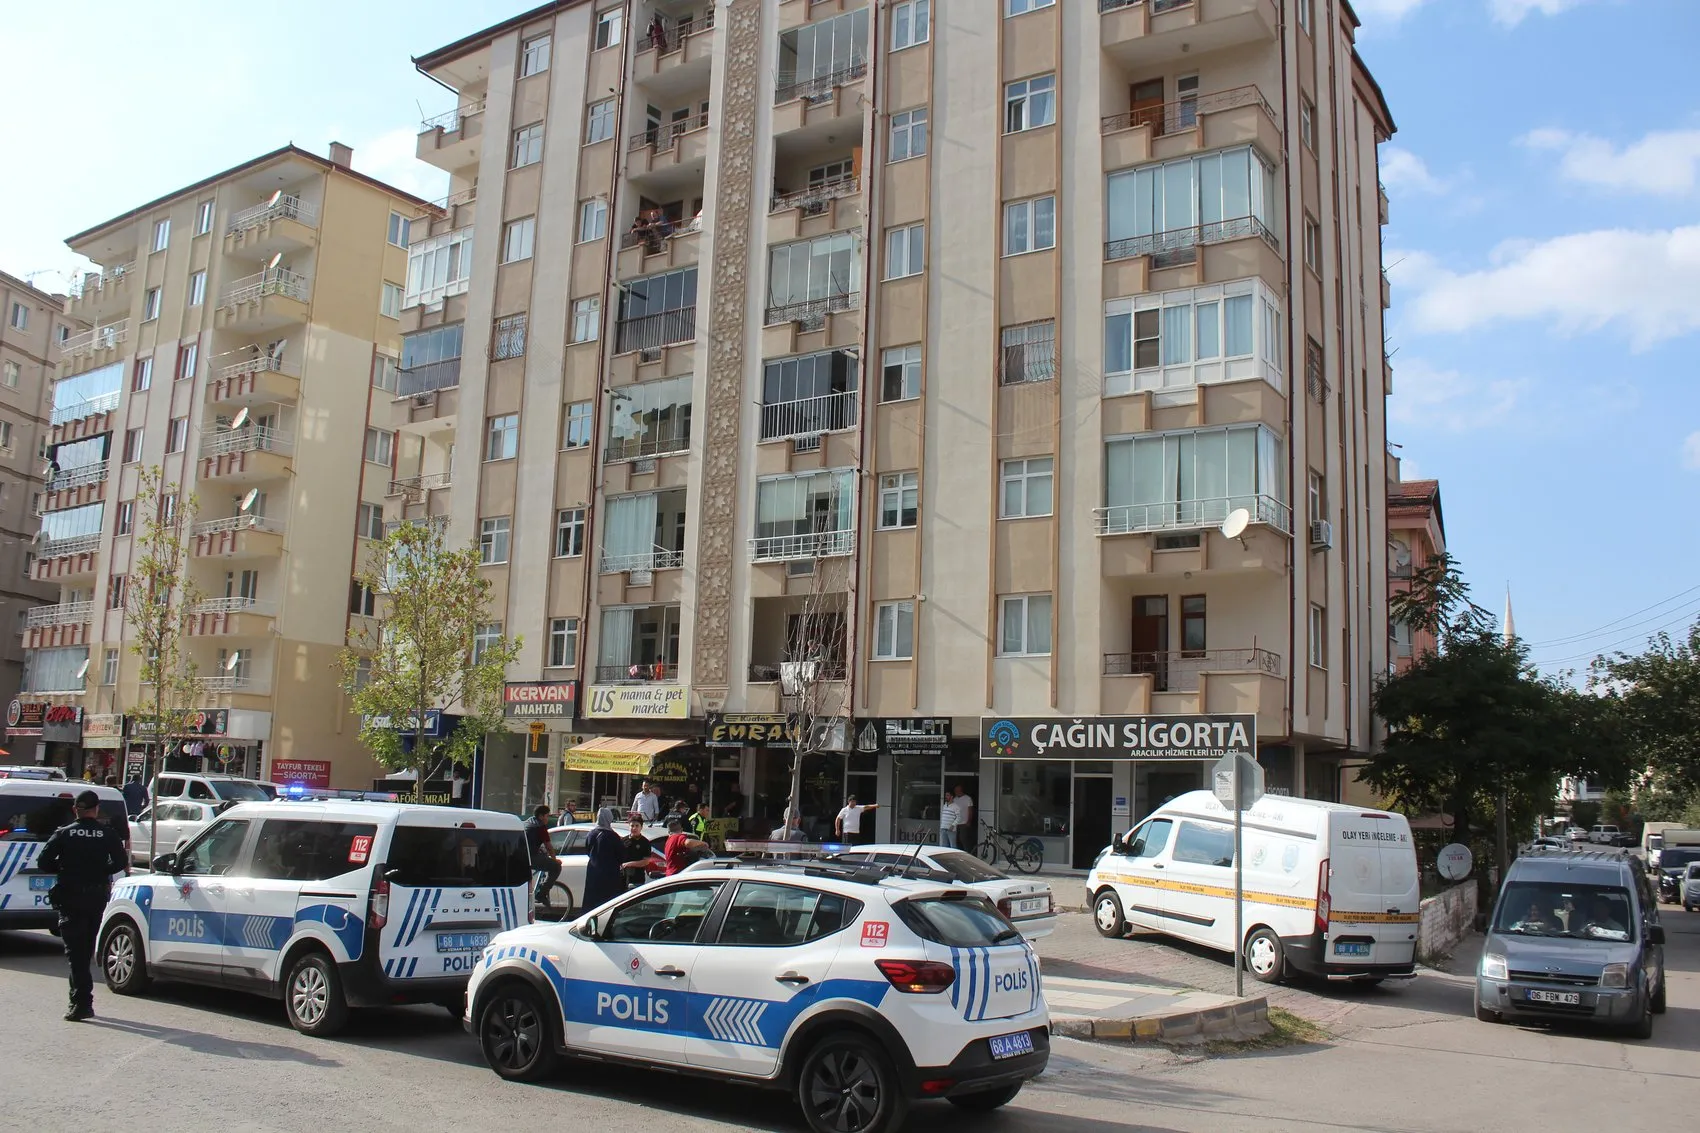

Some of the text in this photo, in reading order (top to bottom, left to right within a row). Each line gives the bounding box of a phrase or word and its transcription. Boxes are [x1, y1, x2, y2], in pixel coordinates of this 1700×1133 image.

[510, 686, 569, 701] KERVAN
[620, 688, 683, 704] mama & pet
[514, 703, 563, 715] ANAHTAR
[631, 703, 669, 714] market
[886, 719, 949, 734] BULAT
[1031, 717, 1249, 755] ÇAĞIN SİGORTA
[1131, 749, 1164, 757] ARACILIK
[1165, 748, 1209, 757] HİZMETLERİ
[1210, 748, 1226, 756] LTD.
[277, 762, 302, 770] TAYFUR
[283, 771, 317, 780] SİGORTA
[69, 828, 104, 838] POLİS
[1342, 830, 1357, 840] OLAY
[355, 838, 368, 851] 112
[168, 914, 204, 938] POLİS
[867, 924, 885, 937] 112
[443, 935, 488, 947] 68 A 4838
[995, 967, 1028, 993] POLİS
[1531, 991, 1541, 1000] 06
[1563, 994, 1578, 1003] 479
[597, 991, 669, 1024] POLİS
[992, 1033, 1030, 1054] 68 A 4813
